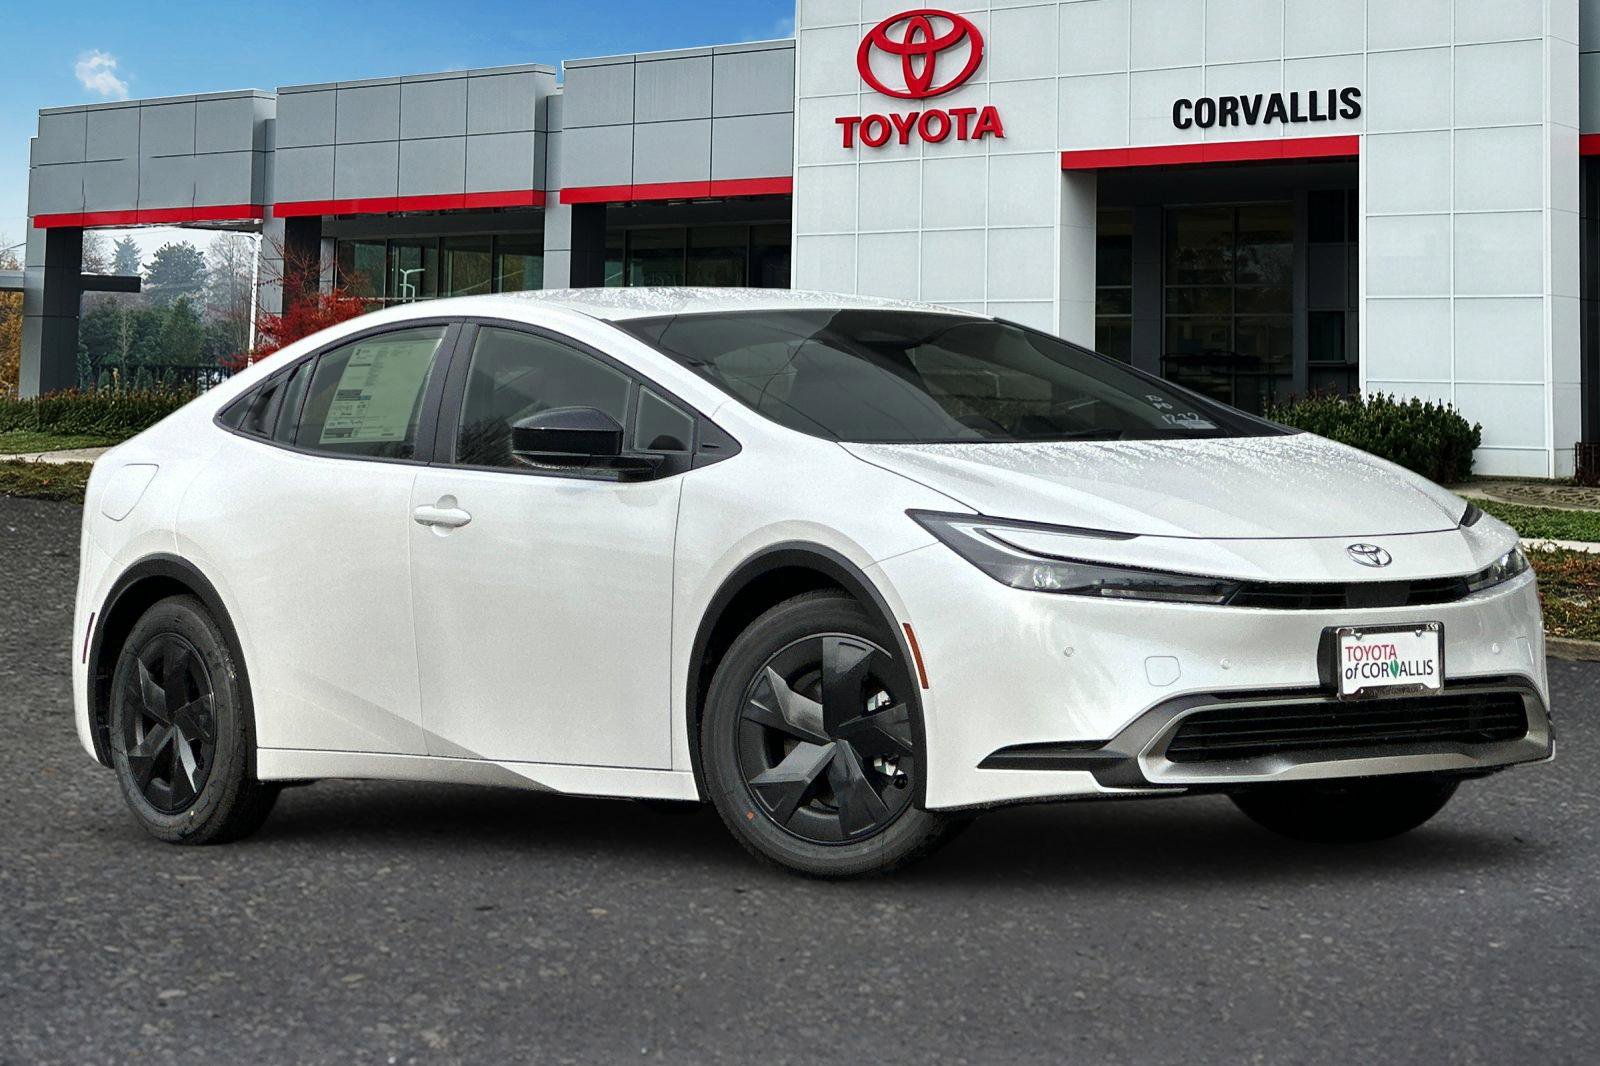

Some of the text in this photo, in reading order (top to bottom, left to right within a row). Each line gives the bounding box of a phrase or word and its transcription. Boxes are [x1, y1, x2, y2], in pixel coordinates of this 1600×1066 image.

[1172, 86, 1362, 130] CORVALLIS
[835, 106, 1006, 149] TOYOTA
[1345, 644, 1397, 662] TOYOTA
[1345, 659, 1434, 680] of CORVALLIS
